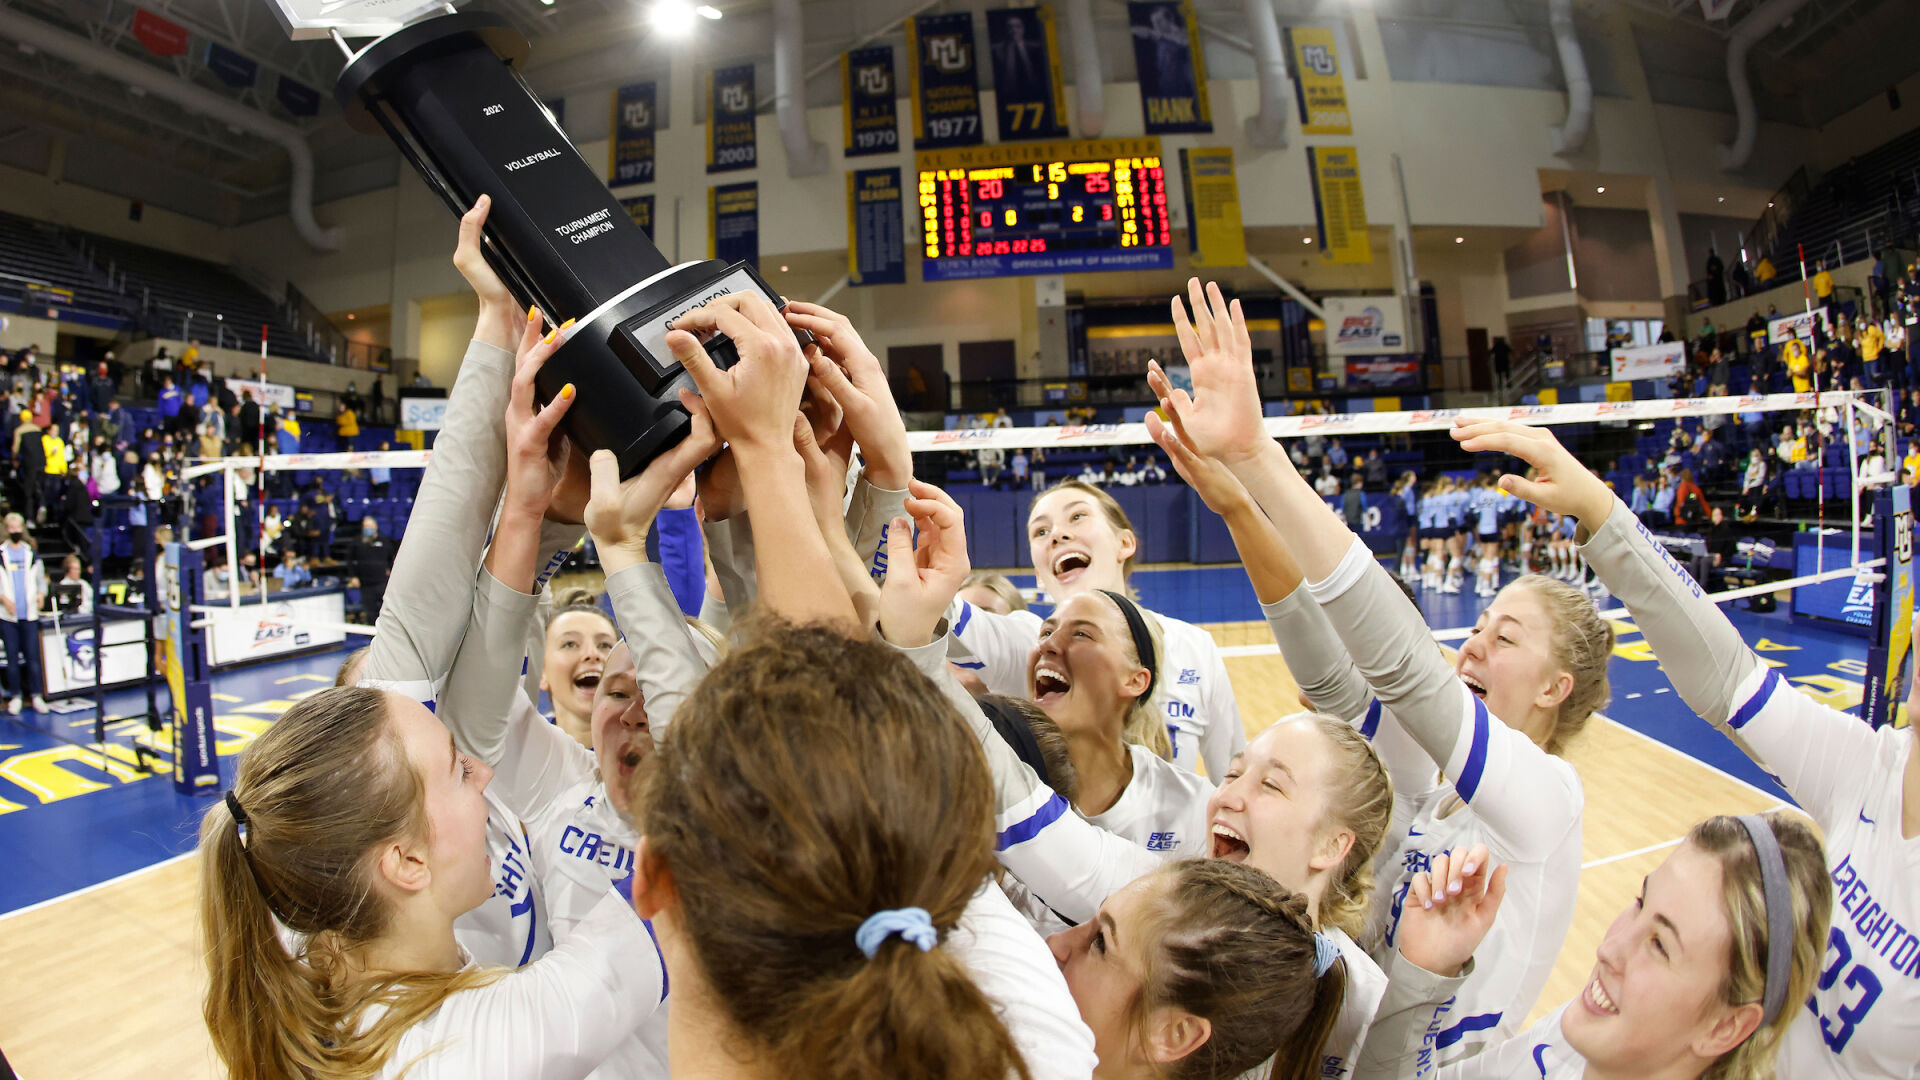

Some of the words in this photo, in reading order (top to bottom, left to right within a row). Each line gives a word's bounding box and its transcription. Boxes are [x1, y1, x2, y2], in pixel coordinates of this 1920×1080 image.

[931, 37, 966, 69] MU
[1304, 45, 1335, 73] MU
[860, 66, 888, 93] MU
[723, 85, 749, 111] MU
[926, 85, 974, 99] NATIONAL
[483, 104, 505, 117] 2021
[927, 98, 977, 113] CHAMPS
[1147, 97, 1195, 123] HANK
[624, 101, 650, 128] MU
[855, 115, 895, 128] CHAMPS
[1006, 103, 1045, 131] 77
[717, 123, 753, 135] FINAL
[928, 115, 978, 138] 1977
[717, 132, 754, 145] FOUR
[857, 130, 897, 147] 1970
[718, 147, 754, 164] 2003
[1071, 141, 1156, 156] CENTER
[504, 148, 562, 172] VOLLEYBALL
[619, 161, 653, 178] 1977
[865, 174, 892, 188] POST
[978, 178, 1004, 199] 20
[1085, 172, 1110, 193] 25
[860, 187, 899, 202] SEASON
[980, 211, 992, 227] 0
[1005, 210, 1017, 226] 0
[1072, 205, 1084, 222] 2
[1102, 204, 1113, 220] 3
[555, 208, 612, 237] TOURNAMENT
[570, 220, 615, 245] CHAMPION
[1011, 258, 1055, 270] OFFICIAL
[1057, 256, 1082, 267] BANK
[1087, 255, 1099, 266] OF
[1101, 253, 1160, 265] MARQUETTE
[1343, 316, 1374, 328] BIG
[1338, 327, 1382, 337] EAST
[408, 404, 447, 423] SoF
[959, 429, 996, 439] EAST
[1083, 423, 1120, 433] EAST
[1636, 520, 1701, 599] BLUEJAYS
[1846, 587, 1874, 606] EA
[255, 625, 293, 640] EAST
[1147, 840, 1181, 850] EAST
[1149, 832, 1176, 841] BIG
